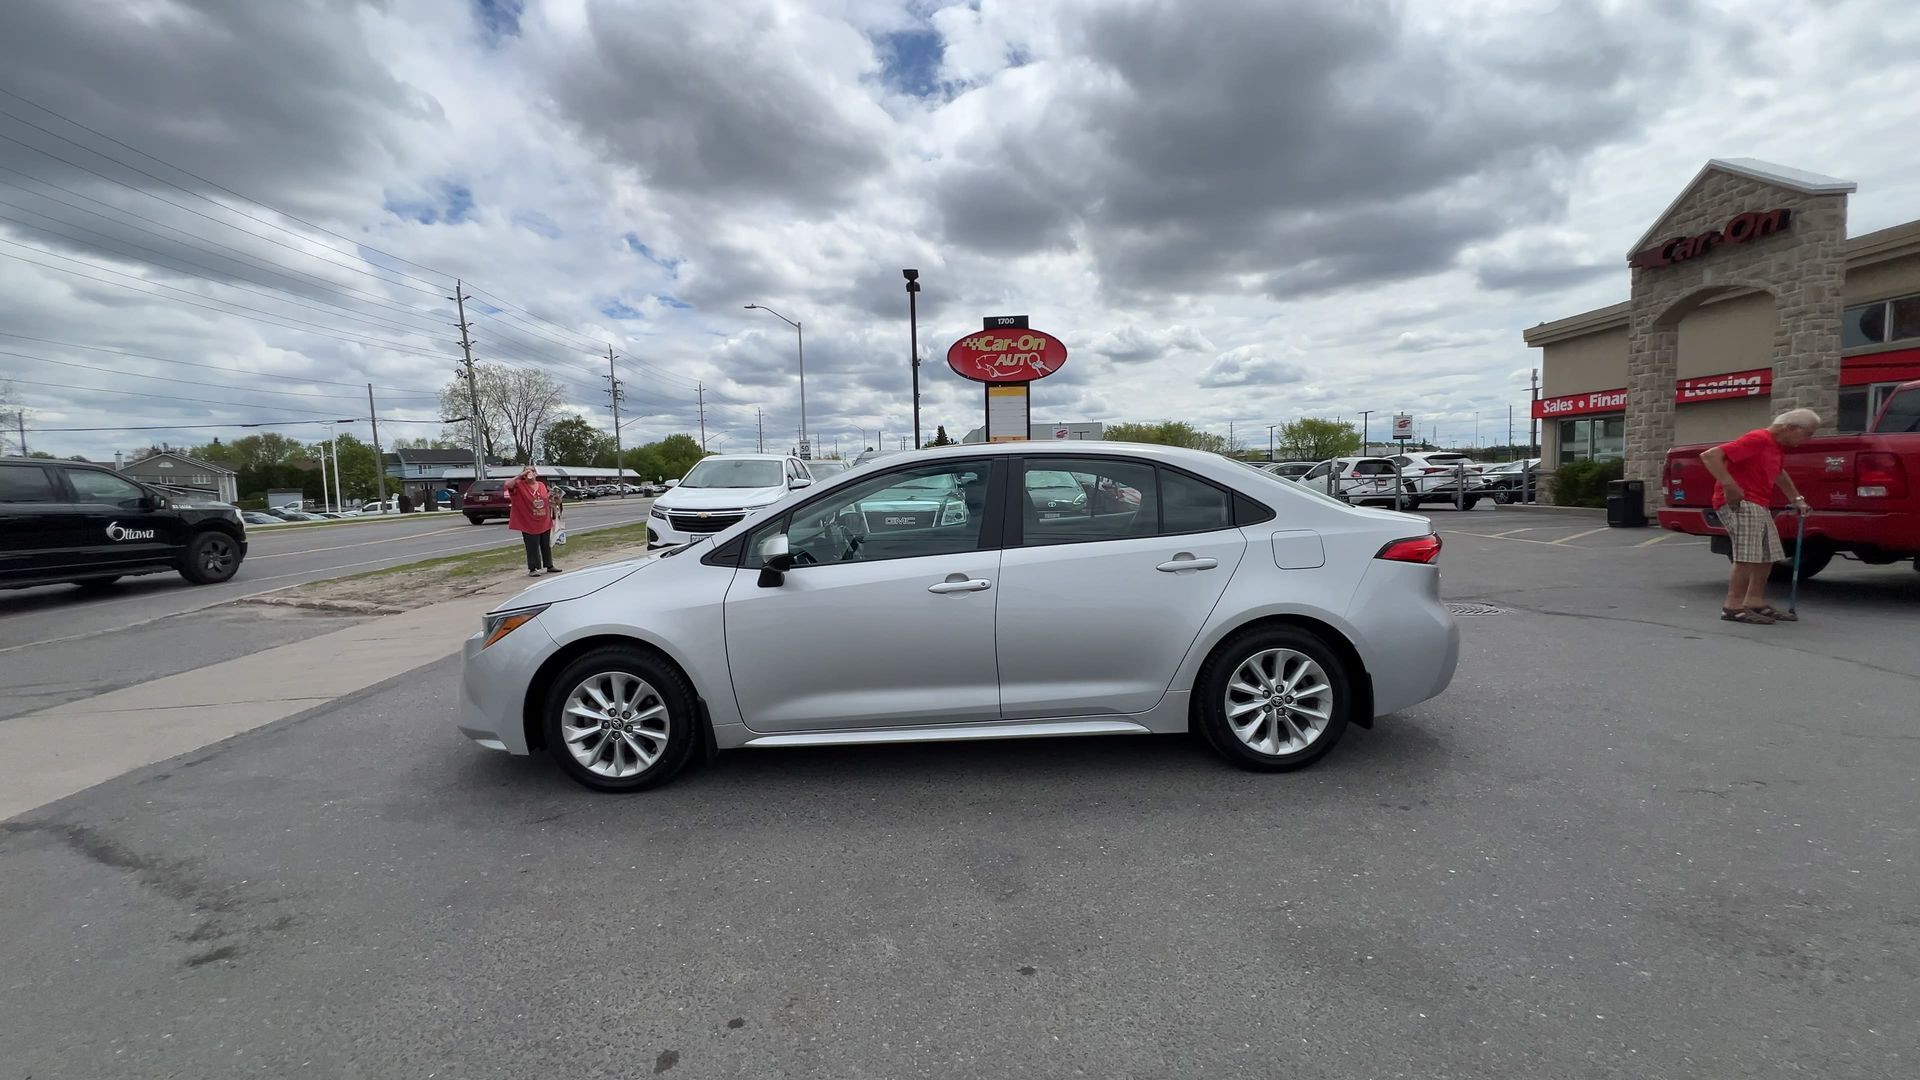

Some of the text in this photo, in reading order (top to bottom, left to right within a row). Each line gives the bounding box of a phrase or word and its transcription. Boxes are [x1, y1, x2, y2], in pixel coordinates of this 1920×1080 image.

[1656, 208, 1791, 269] Car-On
[981, 335, 1046, 352] Car-On
[994, 352, 1041, 367] AUTO
[1684, 376, 1761, 397] Leasing
[1543, 400, 1573, 414] Sales
[885, 516, 916, 525] GMC
[106, 521, 154, 541] Ottawa
